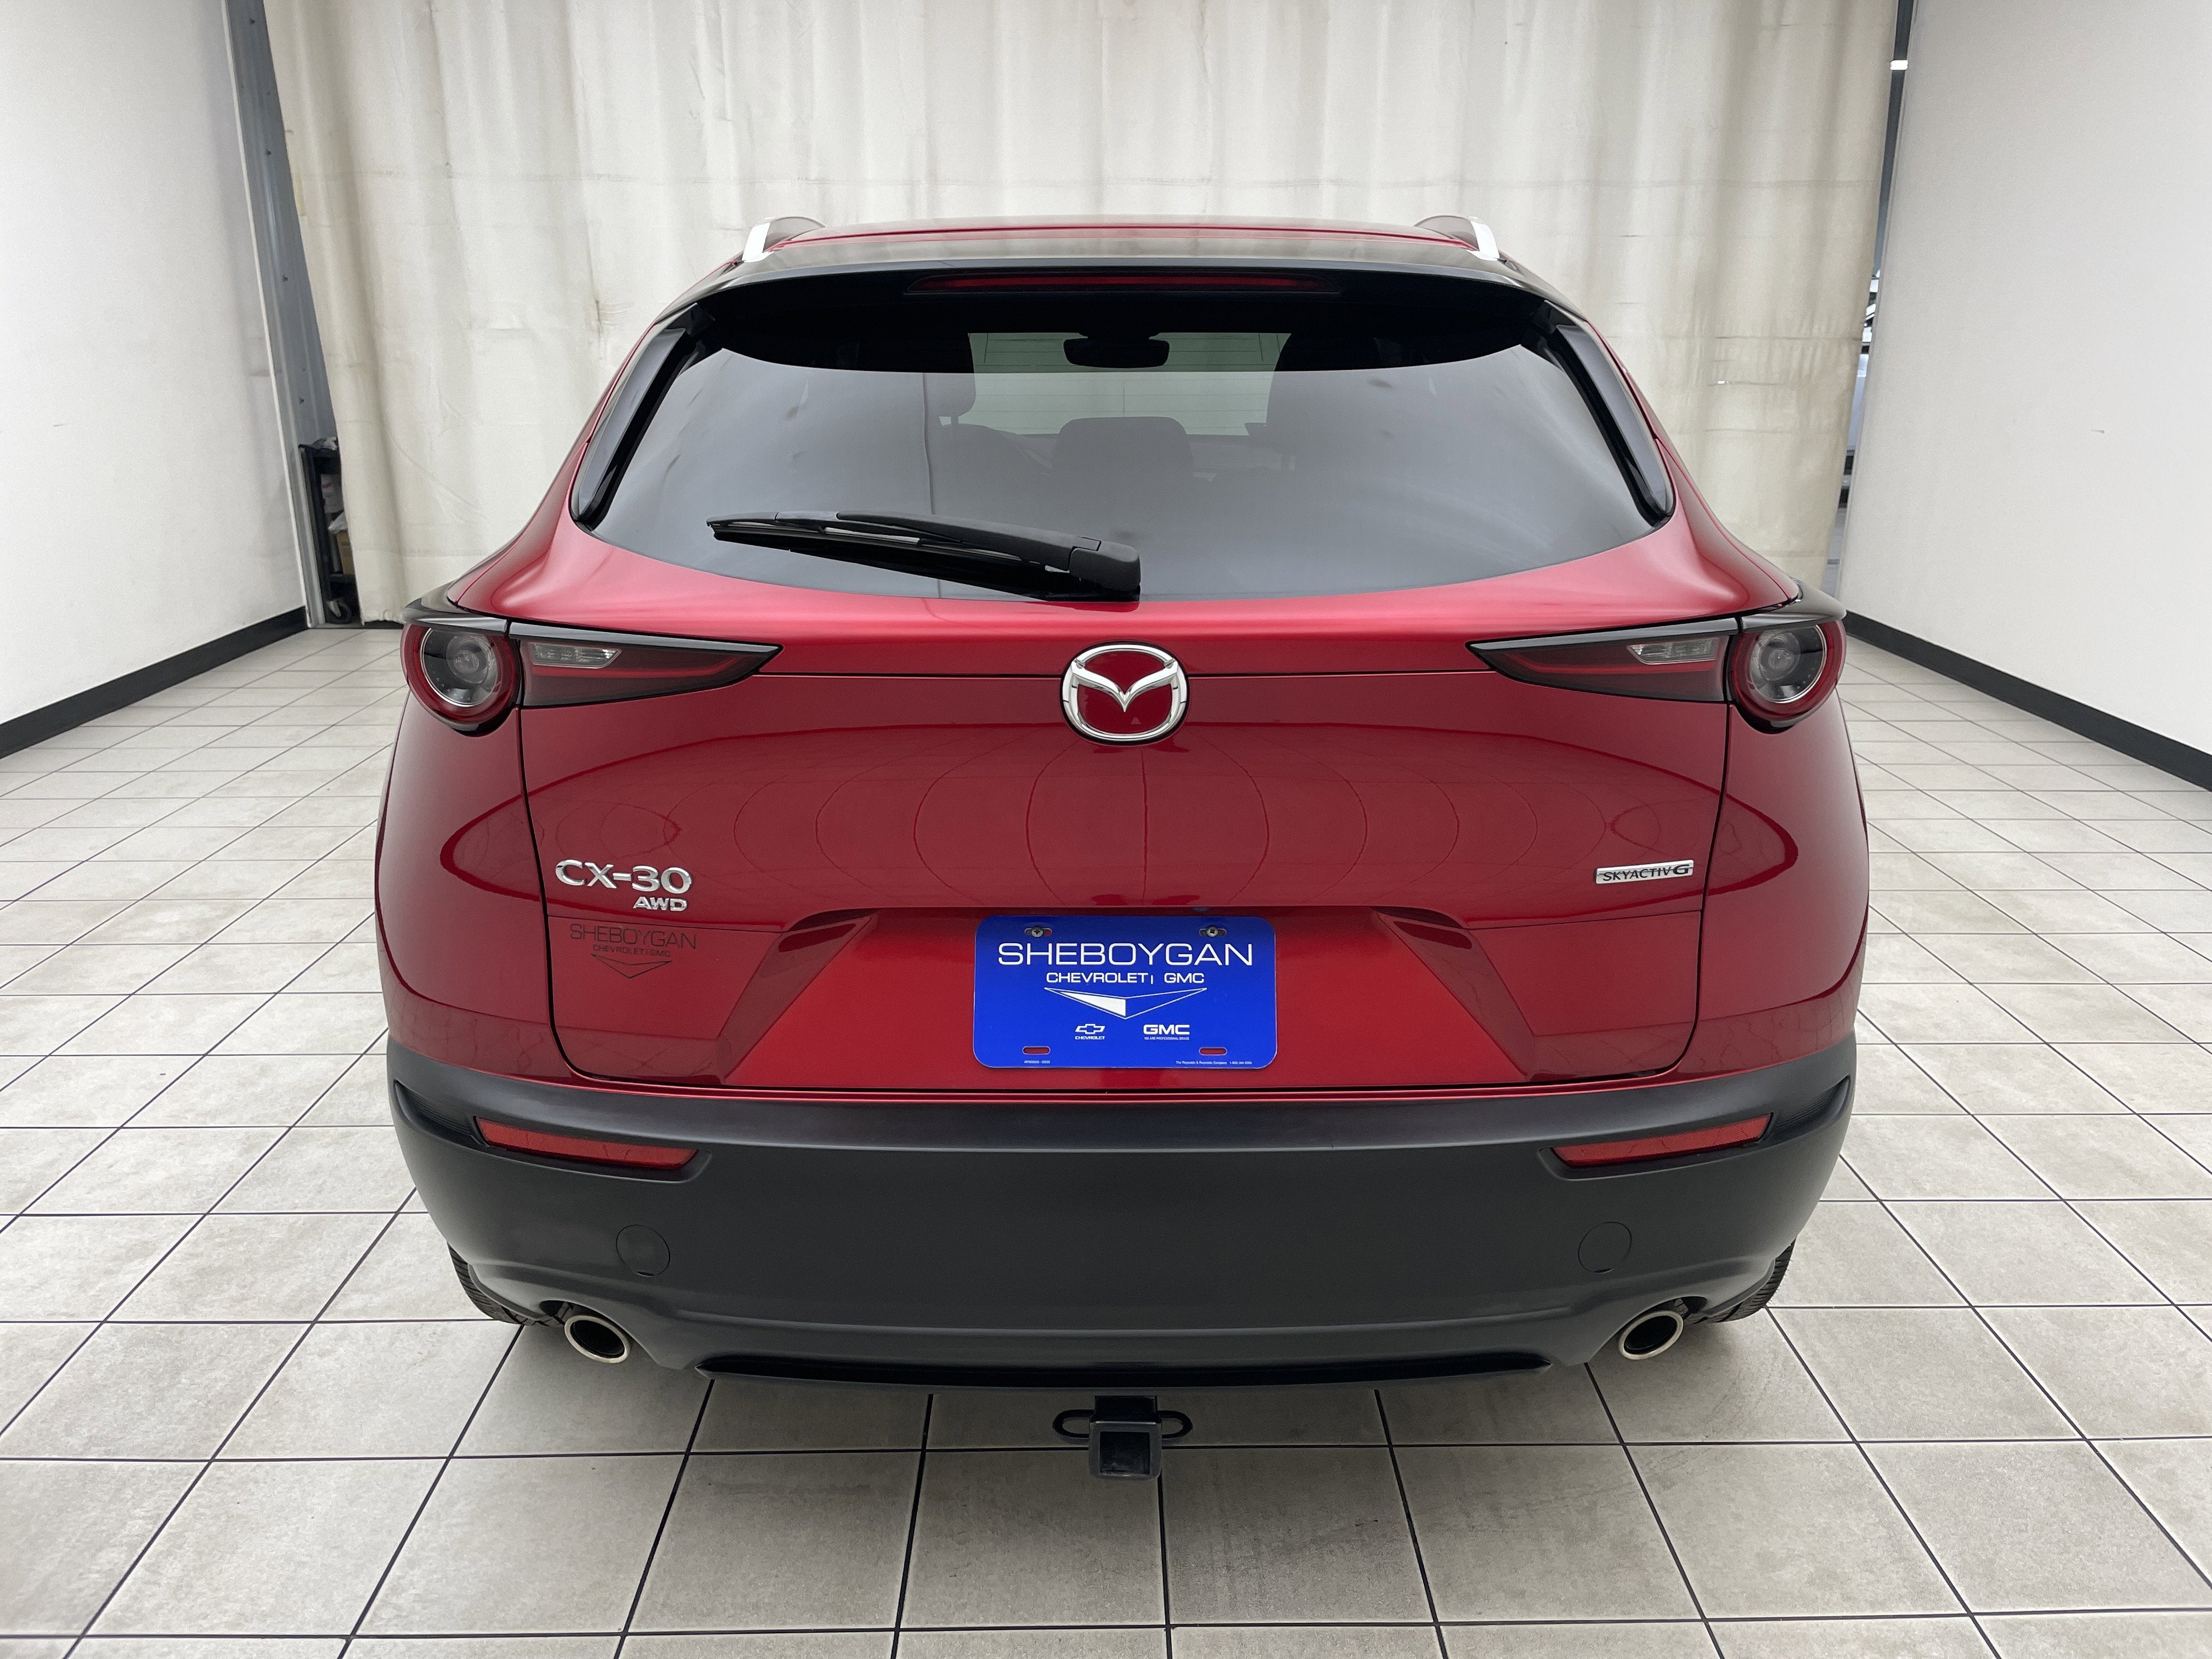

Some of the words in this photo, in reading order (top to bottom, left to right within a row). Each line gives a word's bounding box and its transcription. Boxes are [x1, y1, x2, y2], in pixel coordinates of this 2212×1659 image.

[555, 859, 692, 894] CX-30
[633, 896, 687, 911] AWD
[570, 923, 696, 949] SHEBOYGAN
[592, 944, 644, 955] CHEVROLET
[998, 943, 1252, 966] SHEBOYGAN
[1046, 972, 1149, 984] CHEVROLET
[1164, 972, 1205, 984] GMC
[1143, 1024, 1190, 1035] GMC
